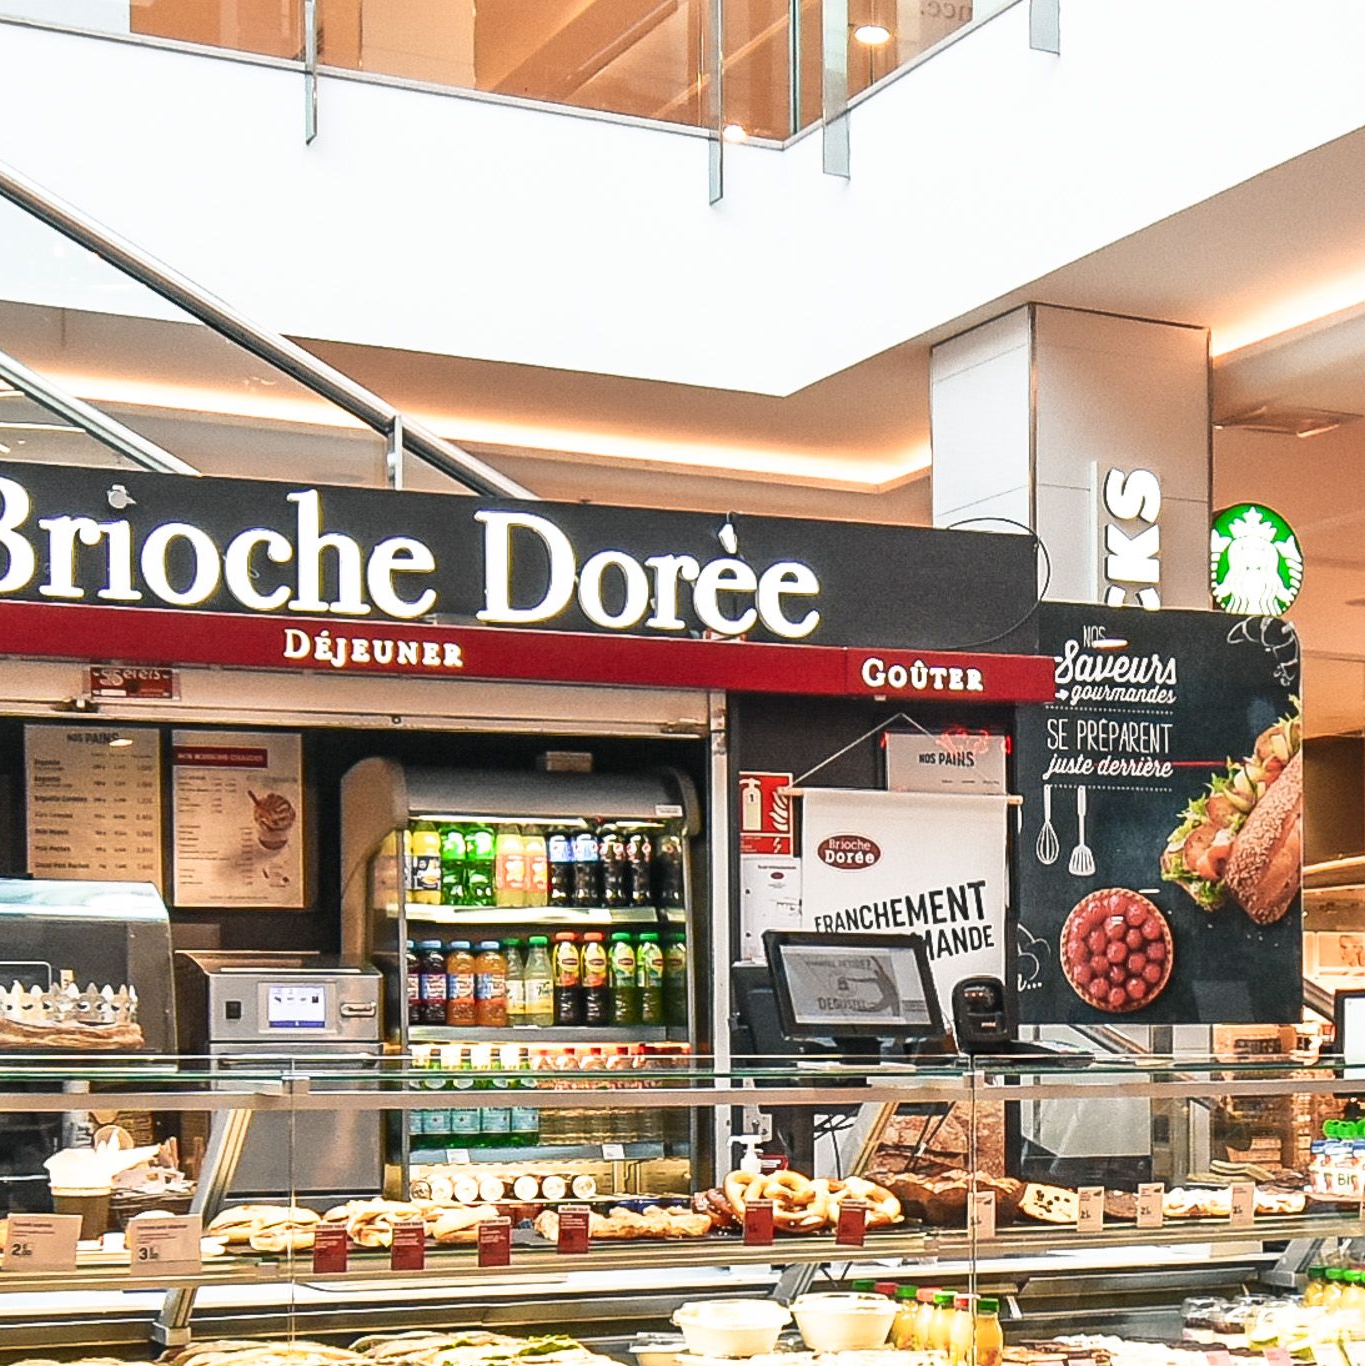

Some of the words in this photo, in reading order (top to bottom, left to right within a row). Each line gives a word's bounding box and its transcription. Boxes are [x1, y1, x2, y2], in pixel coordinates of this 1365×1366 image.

[283, 628, 464, 669] DÉJEUNER
[1083, 625, 1106, 649] NOS
[861, 657, 983, 691] GOÛTER
[1054, 640, 1177, 685] Saveurs
[1070, 683, 1177, 705] gourmandes
[1047, 719, 1069, 750] SE
[919, 753, 935, 765] NOS
[939, 752, 975, 767] PAINS
[1043, 753, 1094, 780] juste
[1096, 755, 1174, 778] derrière
[825, 849, 875, 866] Dorée
[828, 836, 871, 850] Brioche
[814, 880, 986, 933] FRANCHEMENT
[924, 925, 995, 961] MANDE
